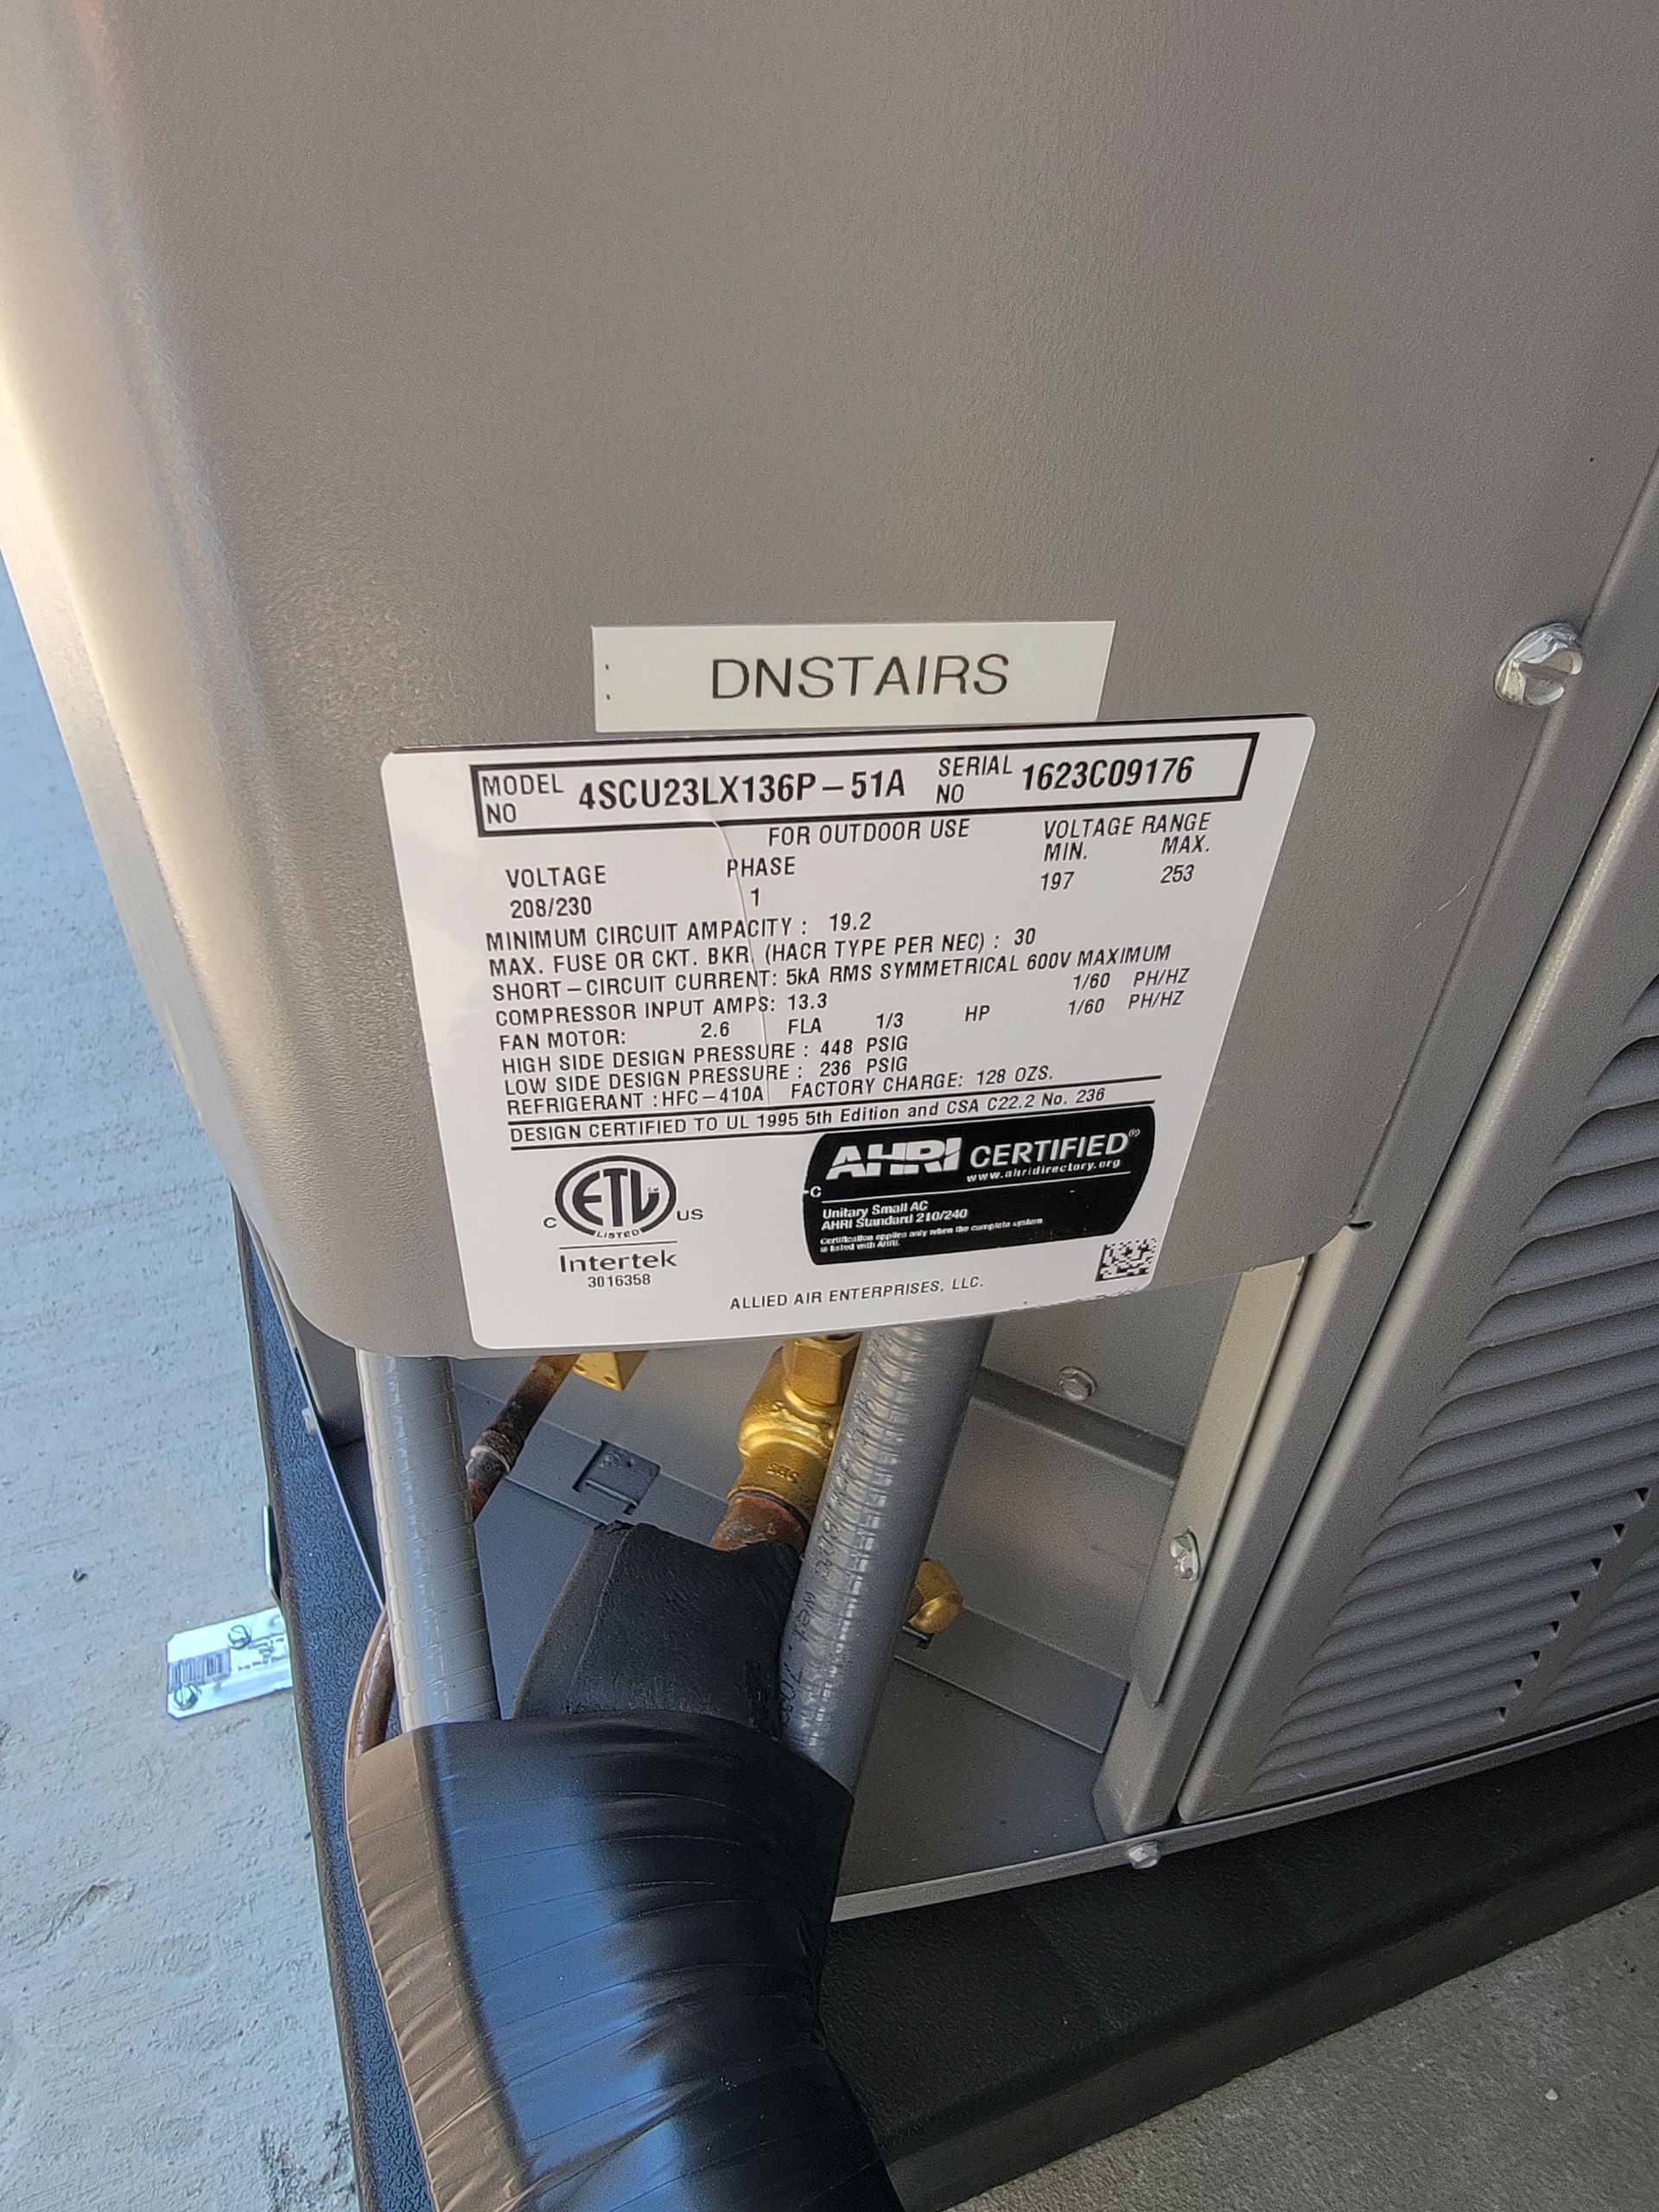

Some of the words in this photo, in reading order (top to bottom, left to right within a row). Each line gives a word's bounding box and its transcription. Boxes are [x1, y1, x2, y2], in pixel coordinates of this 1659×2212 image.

[711, 653, 1010, 699] DNSTAIRS
[938, 756, 1013, 778] SERIAL
[1022, 756, 1195, 791] 1623C09176
[482, 773, 564, 797] MODEL
[936, 784, 964, 804] NO
[486, 803, 517, 823] NO
[769, 825, 810, 847] FOR
[819, 822, 921, 844] OUTDOOR
[931, 818, 969, 838] USE
[1044, 817, 1135, 839] VOLTAGE
[1141, 812, 1211, 834] RANGE
[1044, 842, 1087, 861] MIN.
[1160, 836, 1211, 855] MAX.
[505, 865, 607, 888] VOLTAGE
[727, 856, 797, 878] PHASE
[1160, 864, 1195, 884] 253
[1040, 871, 1075, 891] 197
[511, 896, 593, 918] 208/230
[751, 888, 760, 906] 1
[486, 928, 586, 950] MINIMUM
[596, 924, 678, 944] CIRCUIT
[687, 918, 792, 941] AMPACITY
[830, 912, 871, 932] 19.2
[489, 957, 543, 977] MAX.
[554, 953, 607, 973] FUSE
[615, 952, 644, 969] OR
[652, 949, 697, 968] CKT.
[766, 940, 827, 965] (HACR
[835, 938, 886, 958] TYPE
[894, 936, 933, 954] PER
[941, 931, 985, 952] NEC)
[1014, 928, 1036, 945] 30
[675, 969, 778, 990] CURRENT:
[785, 967, 820, 986] 5kA
[830, 965, 872, 982] RMS
[880, 954, 1019, 980] SYMMETRICAL
[1027, 952, 1071, 970] 600V
[1076, 944, 1172, 967] MAXIMUM
[496, 1003, 637, 1027] COMPRESSOR
[645, 1000, 704, 1019] INPUT
[713, 996, 775, 1015] AMPS:
[787, 993, 828, 1012] 13.3
[1073, 973, 1110, 990] 1/60
[1133, 967, 1190, 988] PH/HZ
[499, 1033, 540, 1051] FAN
[548, 1030, 626, 1048] MOTOR:
[702, 1022, 729, 1038] 2.6
[788, 1018, 822, 1034] FLA
[876, 1013, 904, 1029] 1/3
[964, 1005, 990, 1021] HP
[1068, 998, 1105, 1016] 1/60
[1128, 990, 1185, 1010] PH/HZ
[502, 1056, 551, 1074] HIGH
[560, 1053, 604, 1071] SIDE
[613, 1049, 685, 1068] DESIGN
[694, 1043, 796, 1064] PRESSURE
[820, 1039, 853, 1056] 448
[867, 1036, 908, 1052] PSIG
[505, 1077, 547, 1095] LOW
[556, 1075, 601, 1092] SIDE
[609, 1070, 681, 1090] DESIGN
[690, 1064, 791, 1084] PRESSURE
[819, 1060, 851, 1077] 236
[867, 1057, 907, 1074] PSIG
[507, 1092, 644, 1116] REFRIGERANT
[791, 1077, 874, 1099] FACTORY
[883, 1073, 963, 1093] CHARGE:
[977, 1069, 1006, 1086] 128
[1014, 1065, 1053, 1082] OZS.
[511, 1124, 582, 1142] DESIGN
[589, 1119, 687, 1138] CERTIFIED
[693, 1117, 718, 1132] TO
[727, 1116, 749, 1130] UL
[757, 1113, 798, 1128] 1995
[806, 1109, 832, 1126] 5th
[840, 1103, 899, 1123] Edition
[907, 1102, 938, 1117] and
[946, 1098, 979, 1115] CSA
[987, 1094, 1035, 1111] C22.2
[1041, 1090, 1069, 1107] No.
[1075, 1087, 1105, 1103] 236
[825, 1137, 963, 1180] AHRI
[573, 1168, 659, 1227] ETL
[677, 1209, 704, 1221] US
[821, 1219, 853, 1230] AHRI
[855, 1215, 912, 1228] Standard
[915, 1209, 968, 1224] 210/240
[823, 1208, 868, 1219] Unitary
[872, 1203, 907, 1216] Small
[910, 1200, 928, 1211] AC
[596, 1229, 640, 1239] LISTED
[560, 1250, 677, 1273] Intertek
[588, 1274, 651, 1287] 3016358
[730, 1293, 787, 1310] ALLIED
[794, 1292, 822, 1306] AIR
[952, 1276, 983, 1291] LLC.
